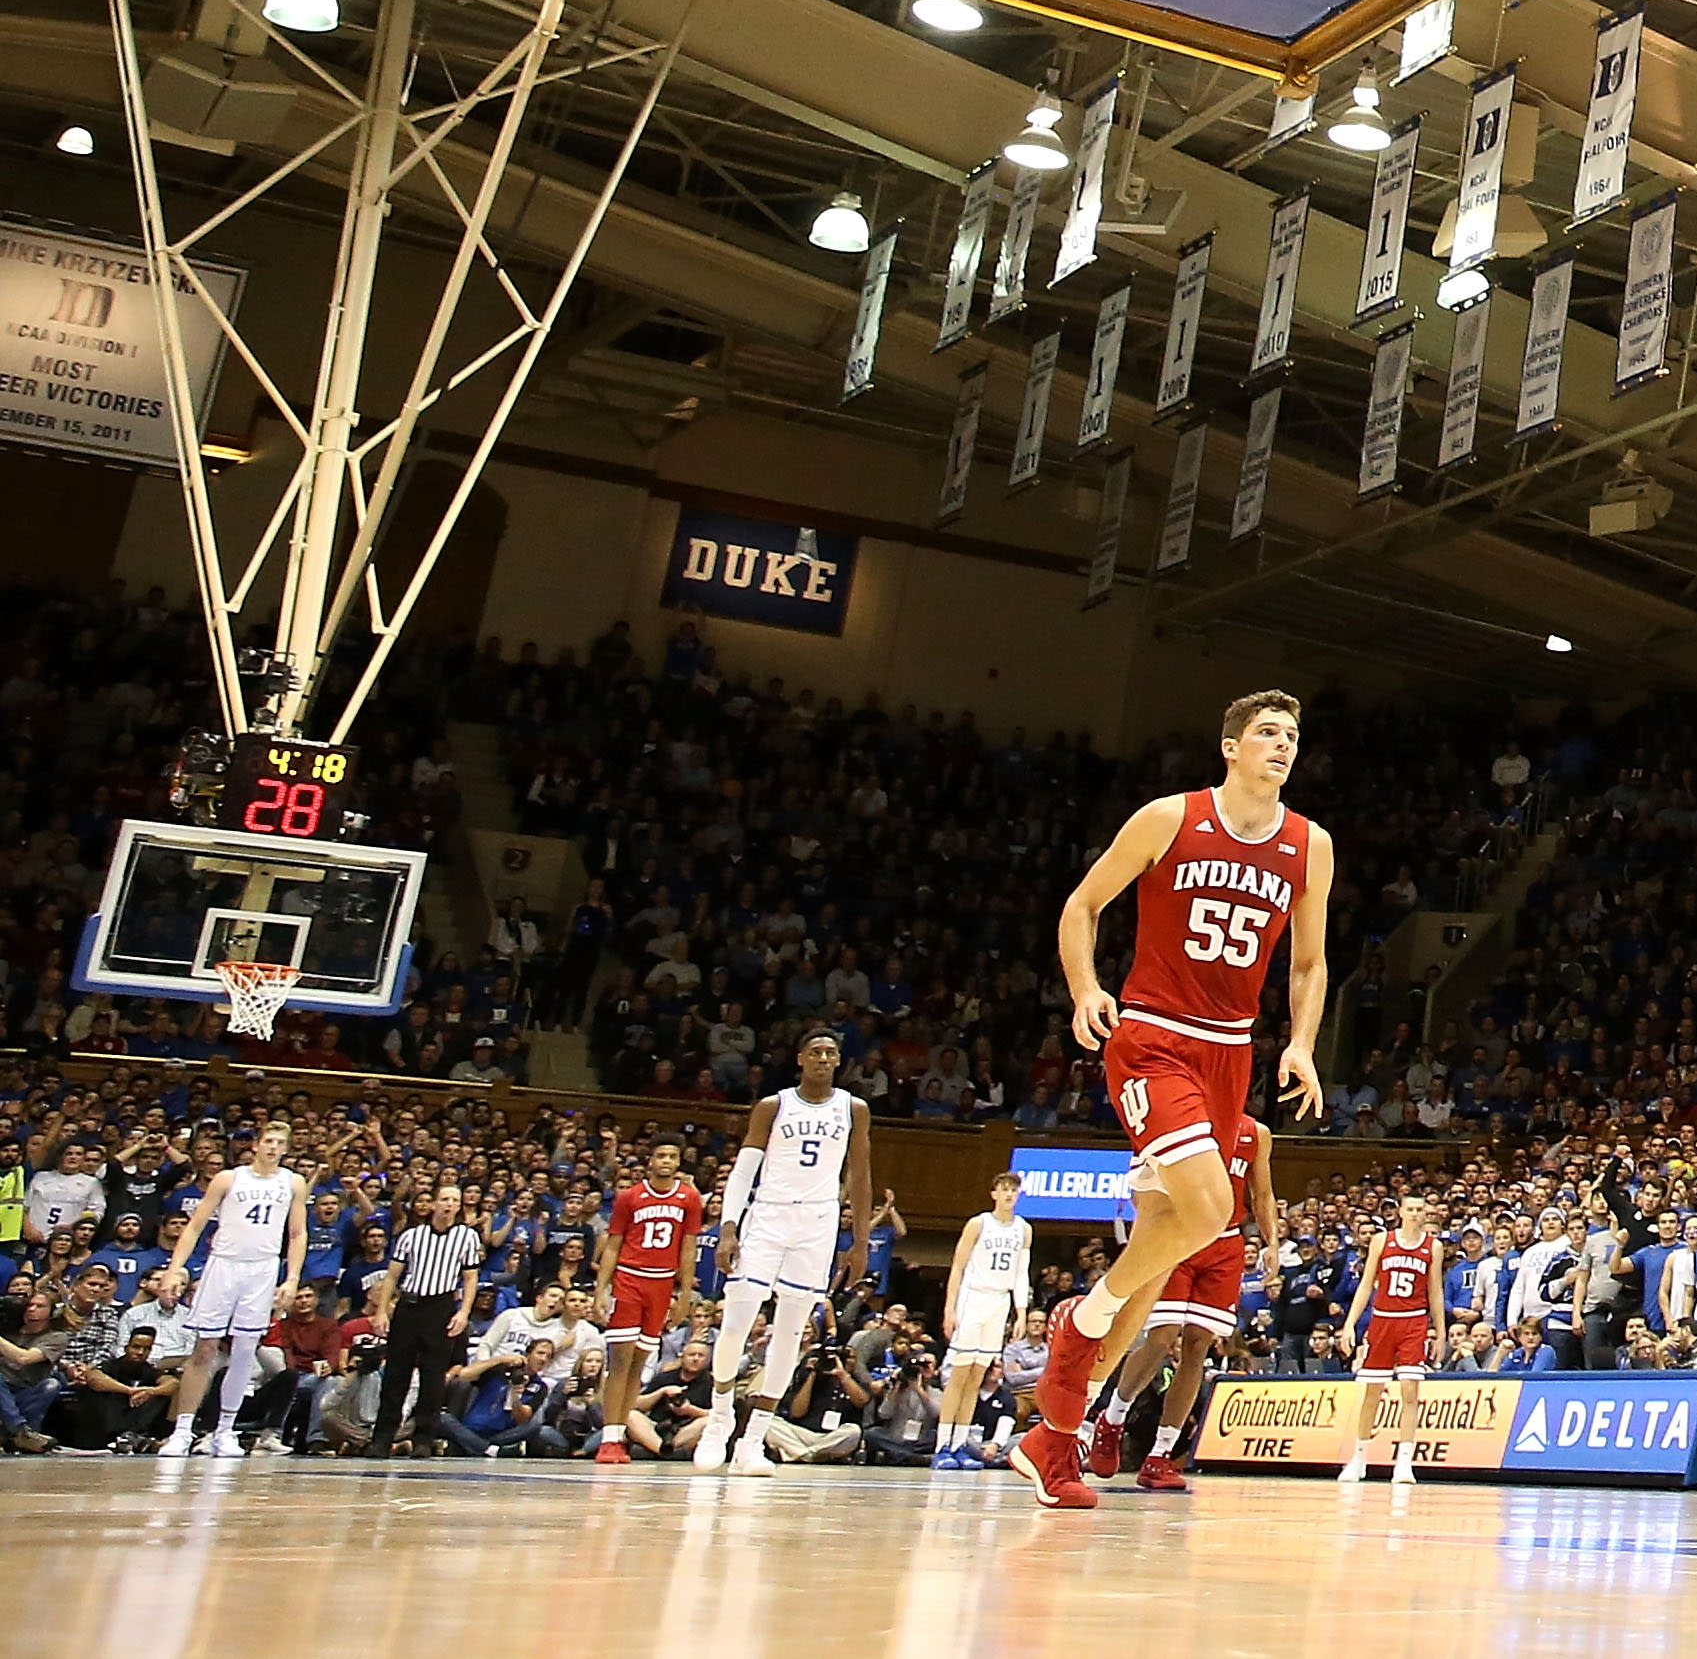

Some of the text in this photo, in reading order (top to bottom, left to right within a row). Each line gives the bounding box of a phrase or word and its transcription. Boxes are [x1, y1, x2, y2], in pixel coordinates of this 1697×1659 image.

[1375, 209, 1391, 258] 1
[32, 355, 98, 382] MOST
[46, 382, 163, 419] VICTORIES
[62, 419, 132, 442] 15, 2011
[683, 536, 838, 604] DUKE
[268, 748, 347, 784] 4:18
[244, 778, 326, 837] 28
[1173, 860, 1294, 914] INDIANA
[1184, 897, 1272, 969] 55
[781, 1123, 846, 1142] DUKE
[799, 1140, 819, 1168] 5
[235, 1189, 289, 1206] DUKE
[245, 1204, 272, 1226] 41
[633, 1204, 685, 1224] INDIANA
[641, 1222, 674, 1249] 13
[983, 1236, 1024, 1255] DUKE
[990, 1252, 1012, 1272] 15
[1380, 1258, 1429, 1275] INDIANA
[1388, 1271, 1415, 1298] 15
[1219, 1387, 1323, 1438] Continental
[1556, 1399, 1690, 1451] DELTA
[1241, 1437, 1295, 1459] TIRE
